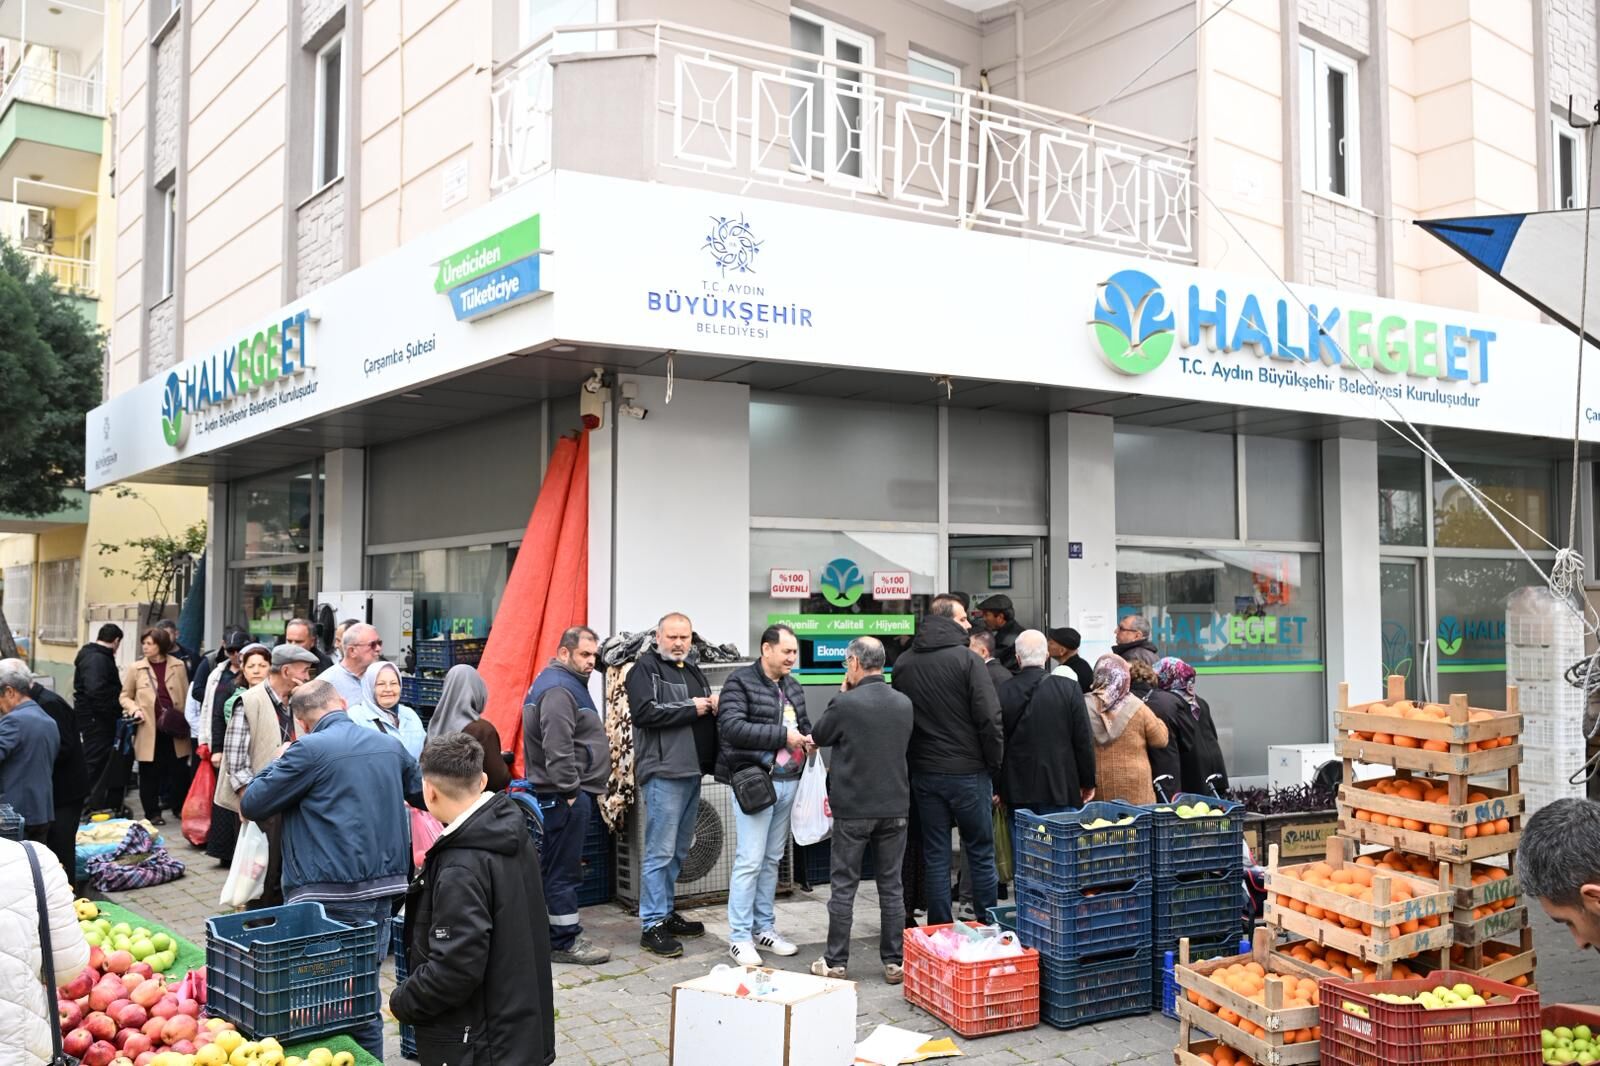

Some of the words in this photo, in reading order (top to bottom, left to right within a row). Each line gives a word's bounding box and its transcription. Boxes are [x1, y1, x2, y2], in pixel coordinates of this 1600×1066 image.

[442, 246, 501, 284] Üreticiden
[459, 273, 520, 312] Tüketiciye
[727, 283, 765, 297] AYDIN
[647, 289, 813, 328] BÜYÜKŞEHİR
[696, 322, 769, 339] BELEDİYESİ
[1186, 284, 1497, 385] HALKEGEET
[184, 308, 312, 415] HALKEGEET
[363, 346, 404, 378] Çarşamba
[406, 332, 436, 365] Şubesi
[1178, 356, 1207, 376] T.C.
[1211, 361, 1254, 383] Aydın
[1258, 367, 1336, 392] Büyükşehir
[1338, 376, 1403, 401] Belediyesi
[1405, 384, 1481, 408] Kuruluşudur
[204, 417, 219, 434] Aydın
[219, 405, 249, 428] Büyükşehir
[249, 392, 278, 417] Belediyesi
[278, 379, 319, 407] Kuruluşudur
[772, 582, 809, 594] GÜVENLİ
[778, 573, 804, 583] %100
[875, 585, 910, 595] GÜVENLİ
[881, 575, 905, 585] %100
[833, 618, 864, 631] Kaliteli
[875, 619, 911, 633] Hijyenik
[1151, 613, 1308, 646] HALKEGEET
